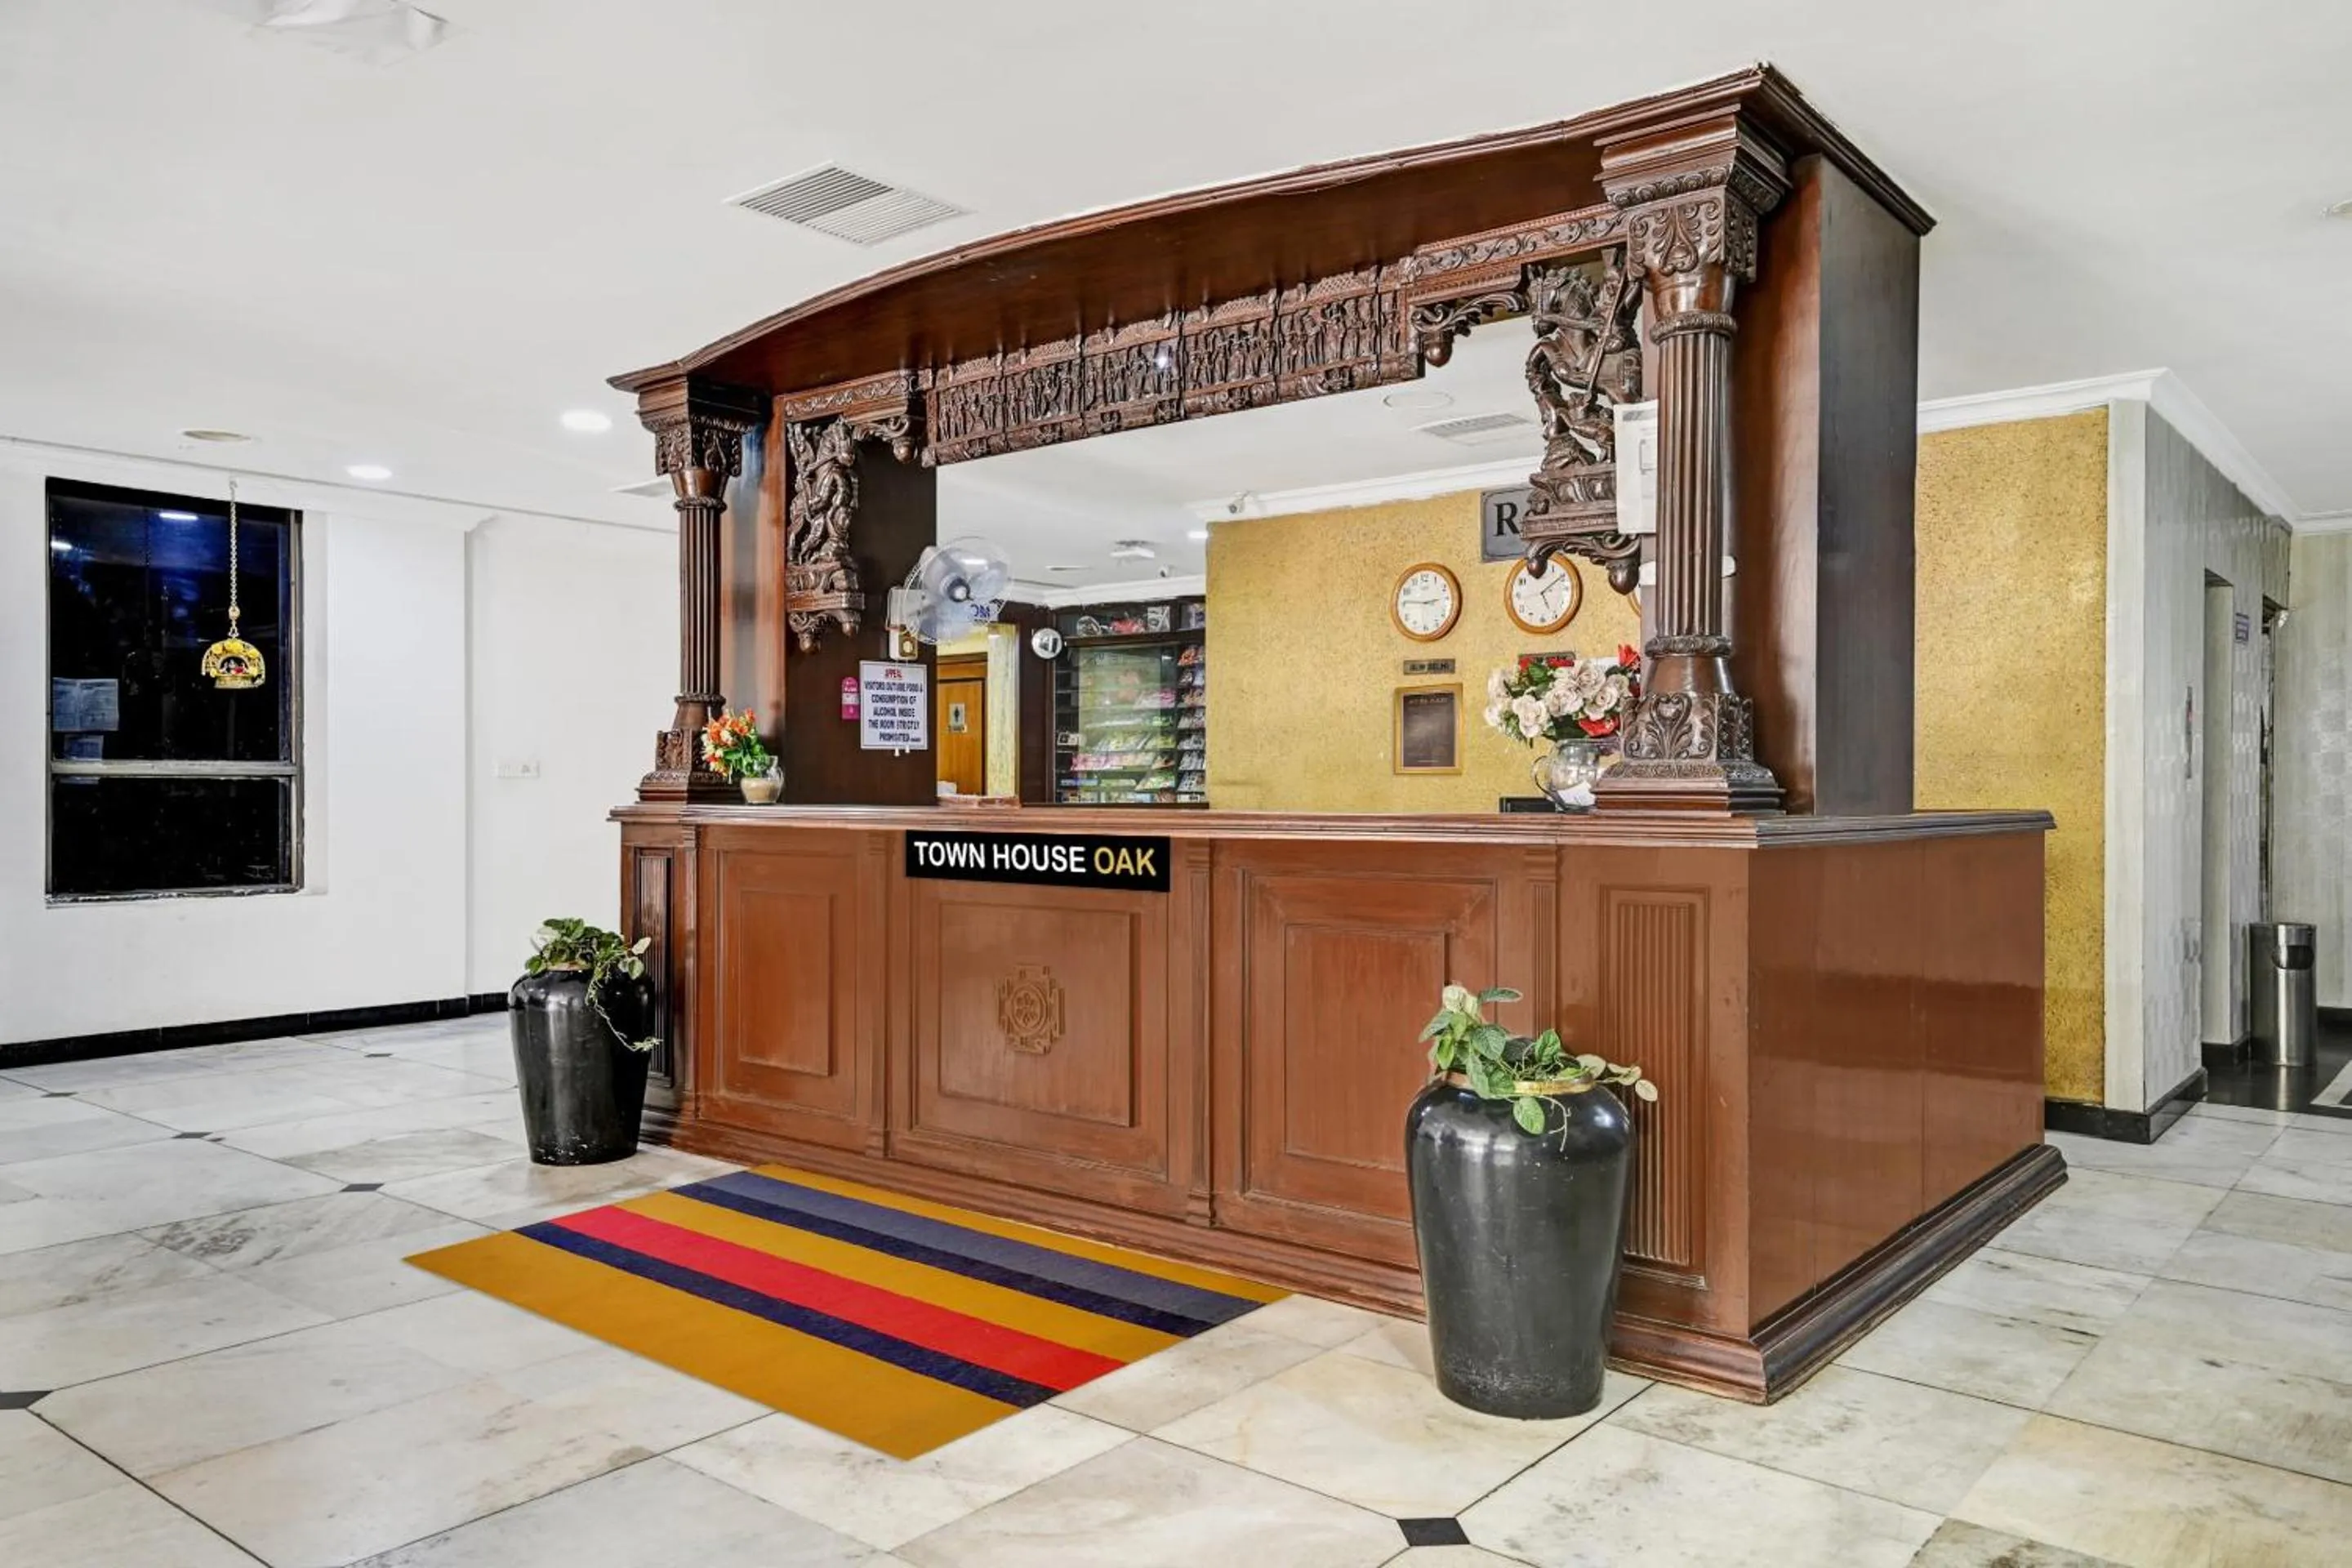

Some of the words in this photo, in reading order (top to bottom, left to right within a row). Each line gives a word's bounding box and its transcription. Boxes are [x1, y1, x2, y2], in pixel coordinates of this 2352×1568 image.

[871, 694, 908, 705] CONSUMPTION
[909, 696, 917, 706] OF
[873, 706, 897, 717] ALCOHOL
[898, 708, 915, 718] INSIDE
[868, 719, 879, 728] THE
[880, 719, 895, 729] ROOM
[897, 720, 920, 730] STRICTLY
[914, 841, 985, 869] TOWN
[992, 844, 1086, 873] HOUSE
[1094, 847, 1156, 876] OAK
